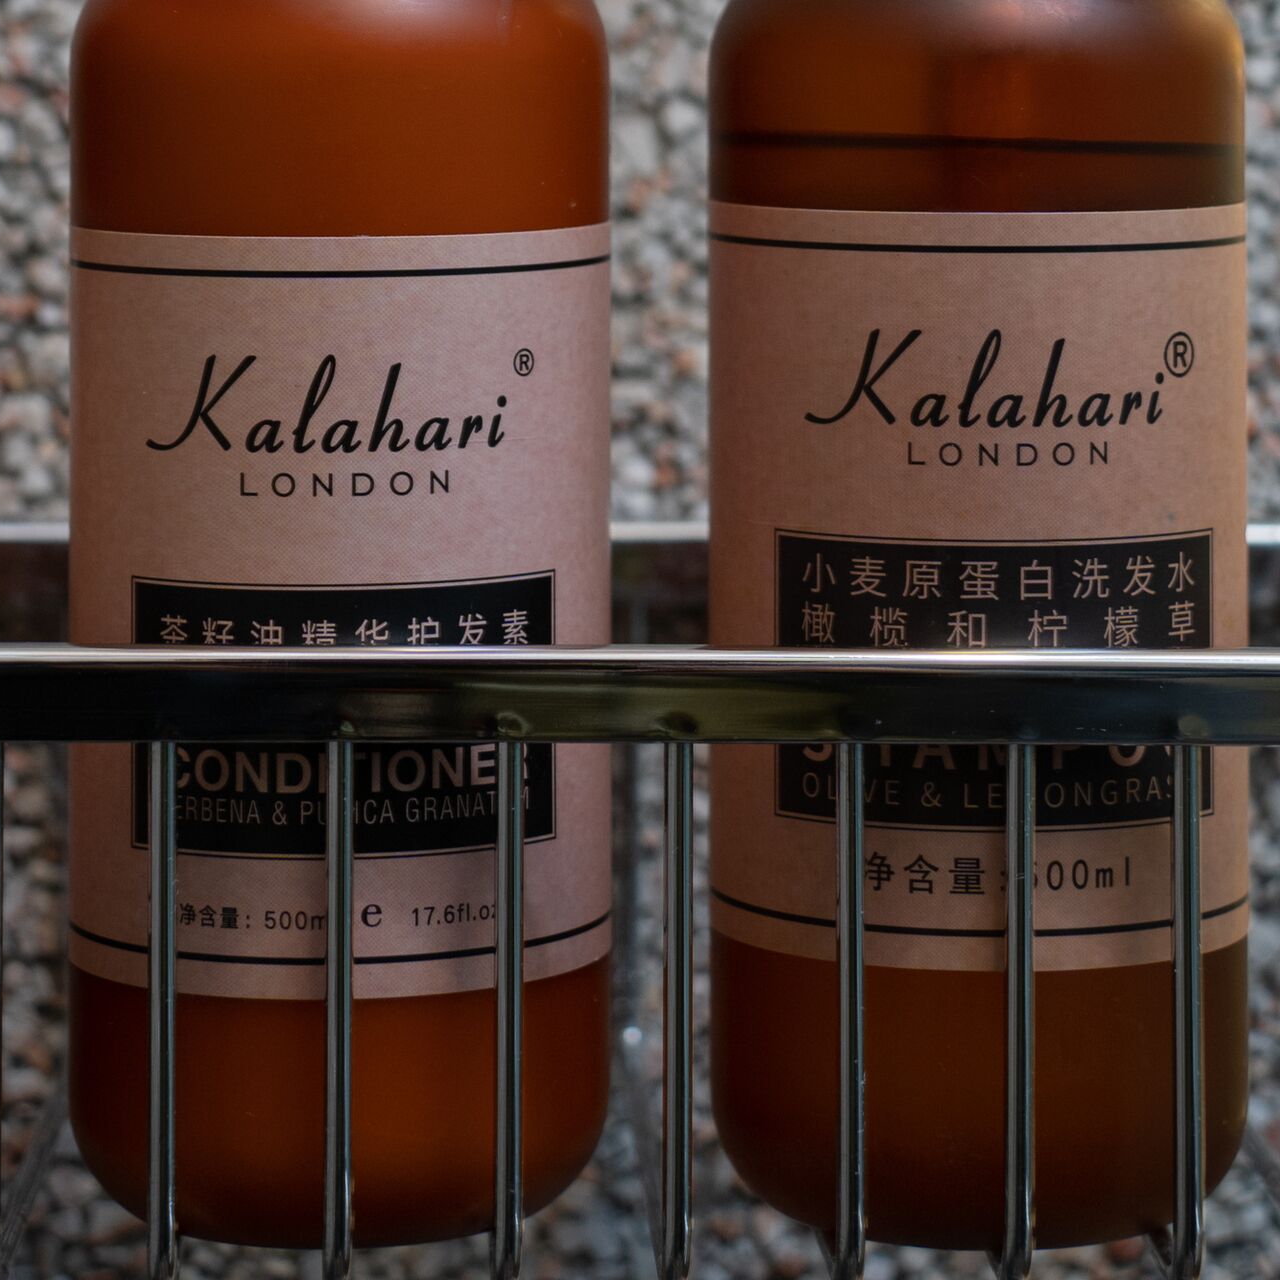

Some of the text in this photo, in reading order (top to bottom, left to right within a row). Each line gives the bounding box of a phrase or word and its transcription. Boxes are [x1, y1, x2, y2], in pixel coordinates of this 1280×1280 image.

[907, 440, 1110, 467] LONDON
[239, 469, 451, 497] LONDON
[801, 550, 1196, 601] 小麦原蛋白洗发水
[801, 600, 1197, 647] 橄榄和柠檬草
[176, 786, 530, 826] ERBENA & PUICA GRANAT
[802, 772, 1173, 809] OLVE & LEONGRA
